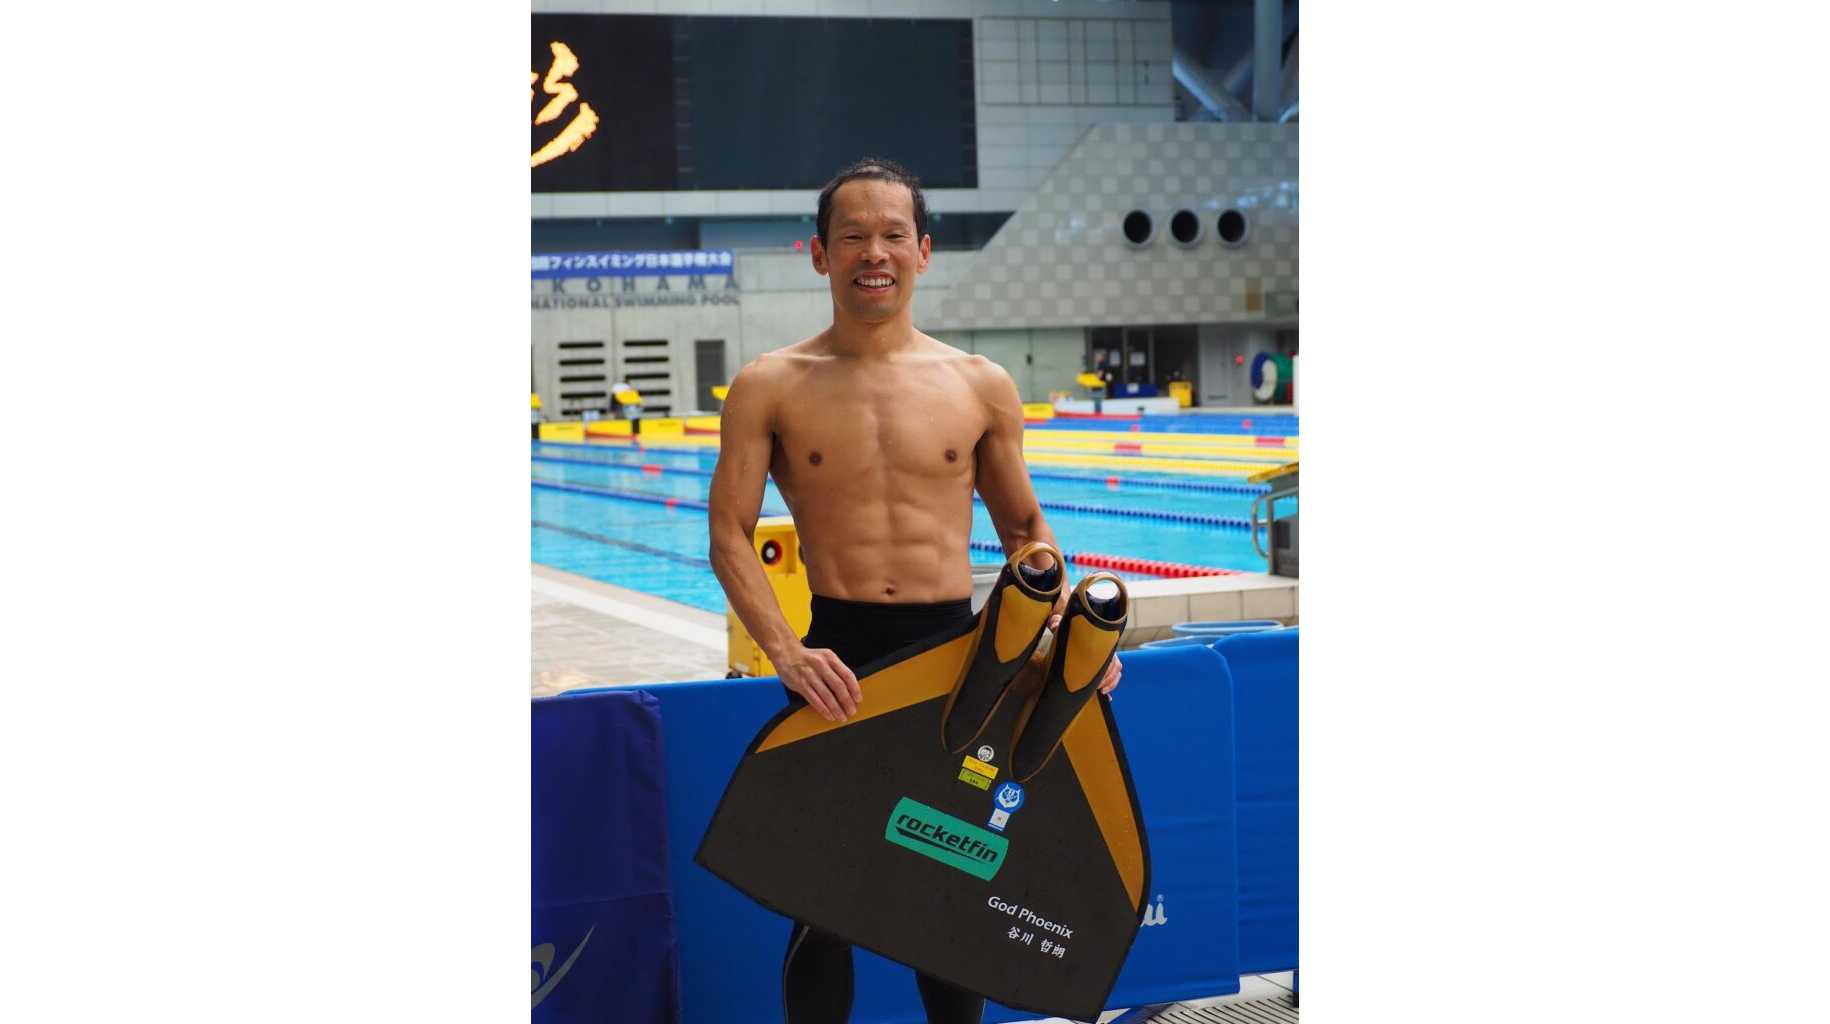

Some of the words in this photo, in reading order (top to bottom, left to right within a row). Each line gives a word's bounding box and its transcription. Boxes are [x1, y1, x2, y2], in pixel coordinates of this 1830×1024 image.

[612, 293, 698, 307] SWIMMING
[701, 291, 740, 305] POOL
[896, 814, 998, 863] rocketfin
[987, 896, 1018, 915] God
[1018, 907, 1073, 939] Phoenix
[1008, 926, 1034, 945] 谷川
[1040, 938, 1066, 958] 哲朗
